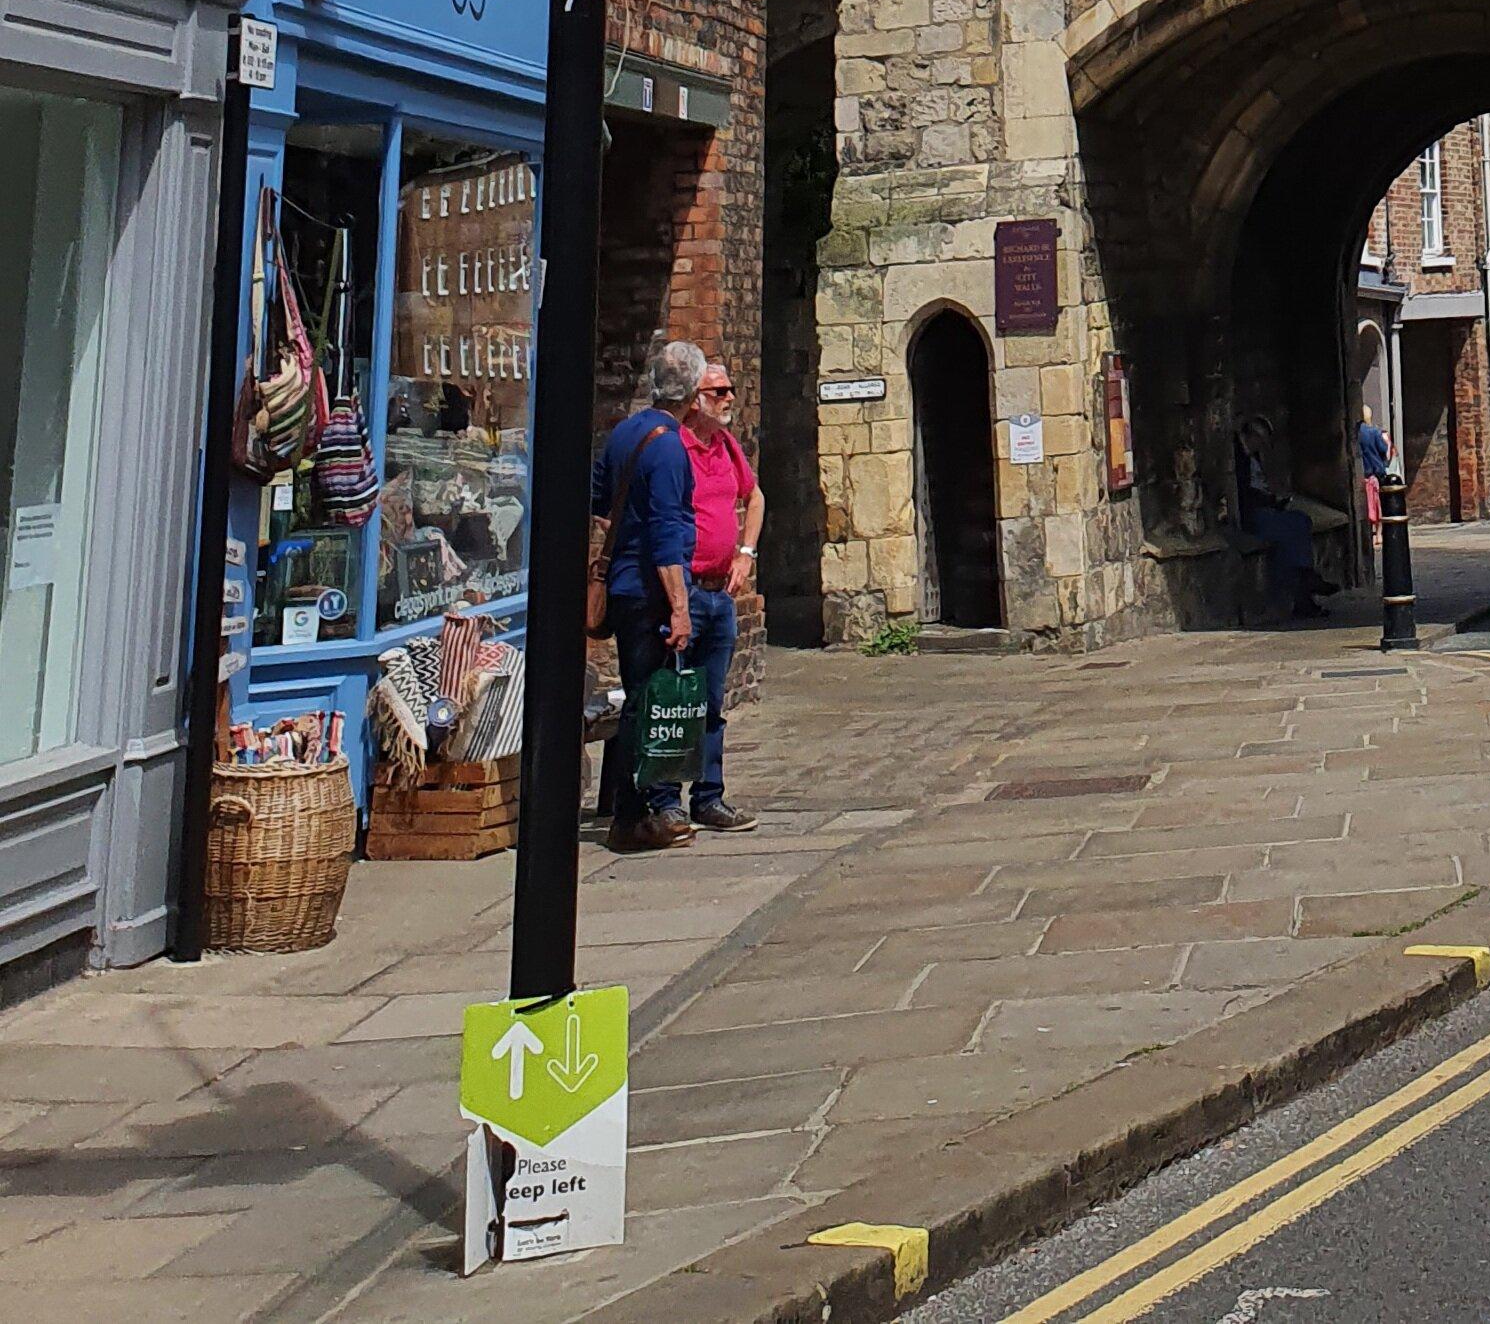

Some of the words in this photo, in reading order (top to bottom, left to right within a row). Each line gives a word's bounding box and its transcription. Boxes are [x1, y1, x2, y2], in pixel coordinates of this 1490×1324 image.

[649, 723, 685, 742] style
[518, 1158, 567, 1175] Please
[505, 1184, 545, 1202] eep
[551, 1175, 587, 1195] left
